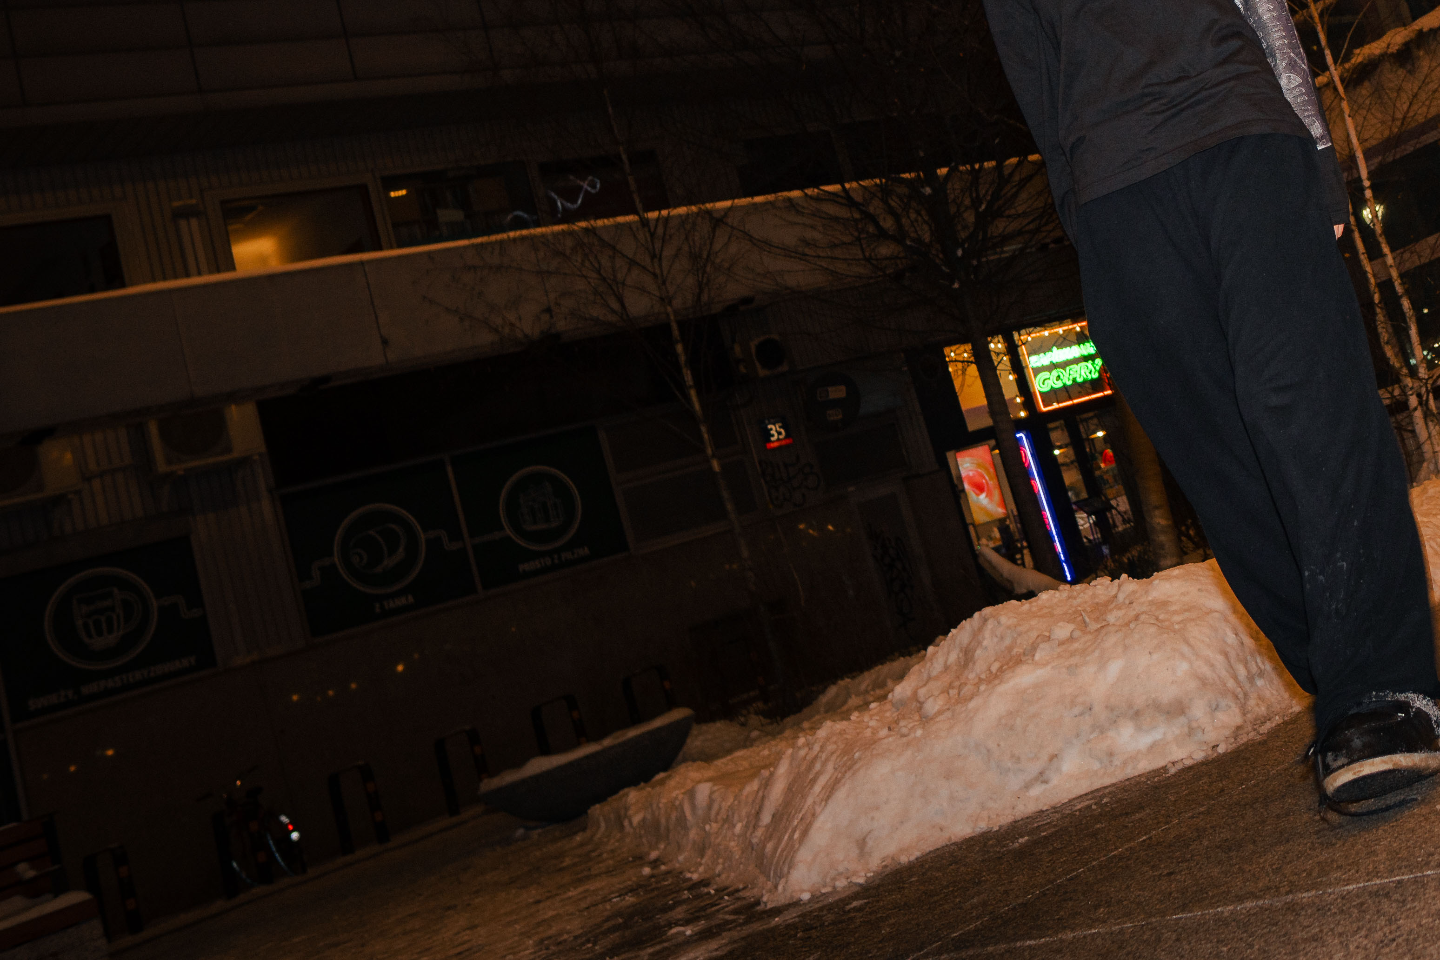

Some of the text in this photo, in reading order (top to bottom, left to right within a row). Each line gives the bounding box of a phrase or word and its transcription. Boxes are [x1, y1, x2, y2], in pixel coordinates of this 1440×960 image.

[1035, 358, 1103, 392] GOFRY
[767, 422, 787, 442] 35
[518, 556, 551, 573] PROSTO
[375, 593, 414, 613] Z TANKA
